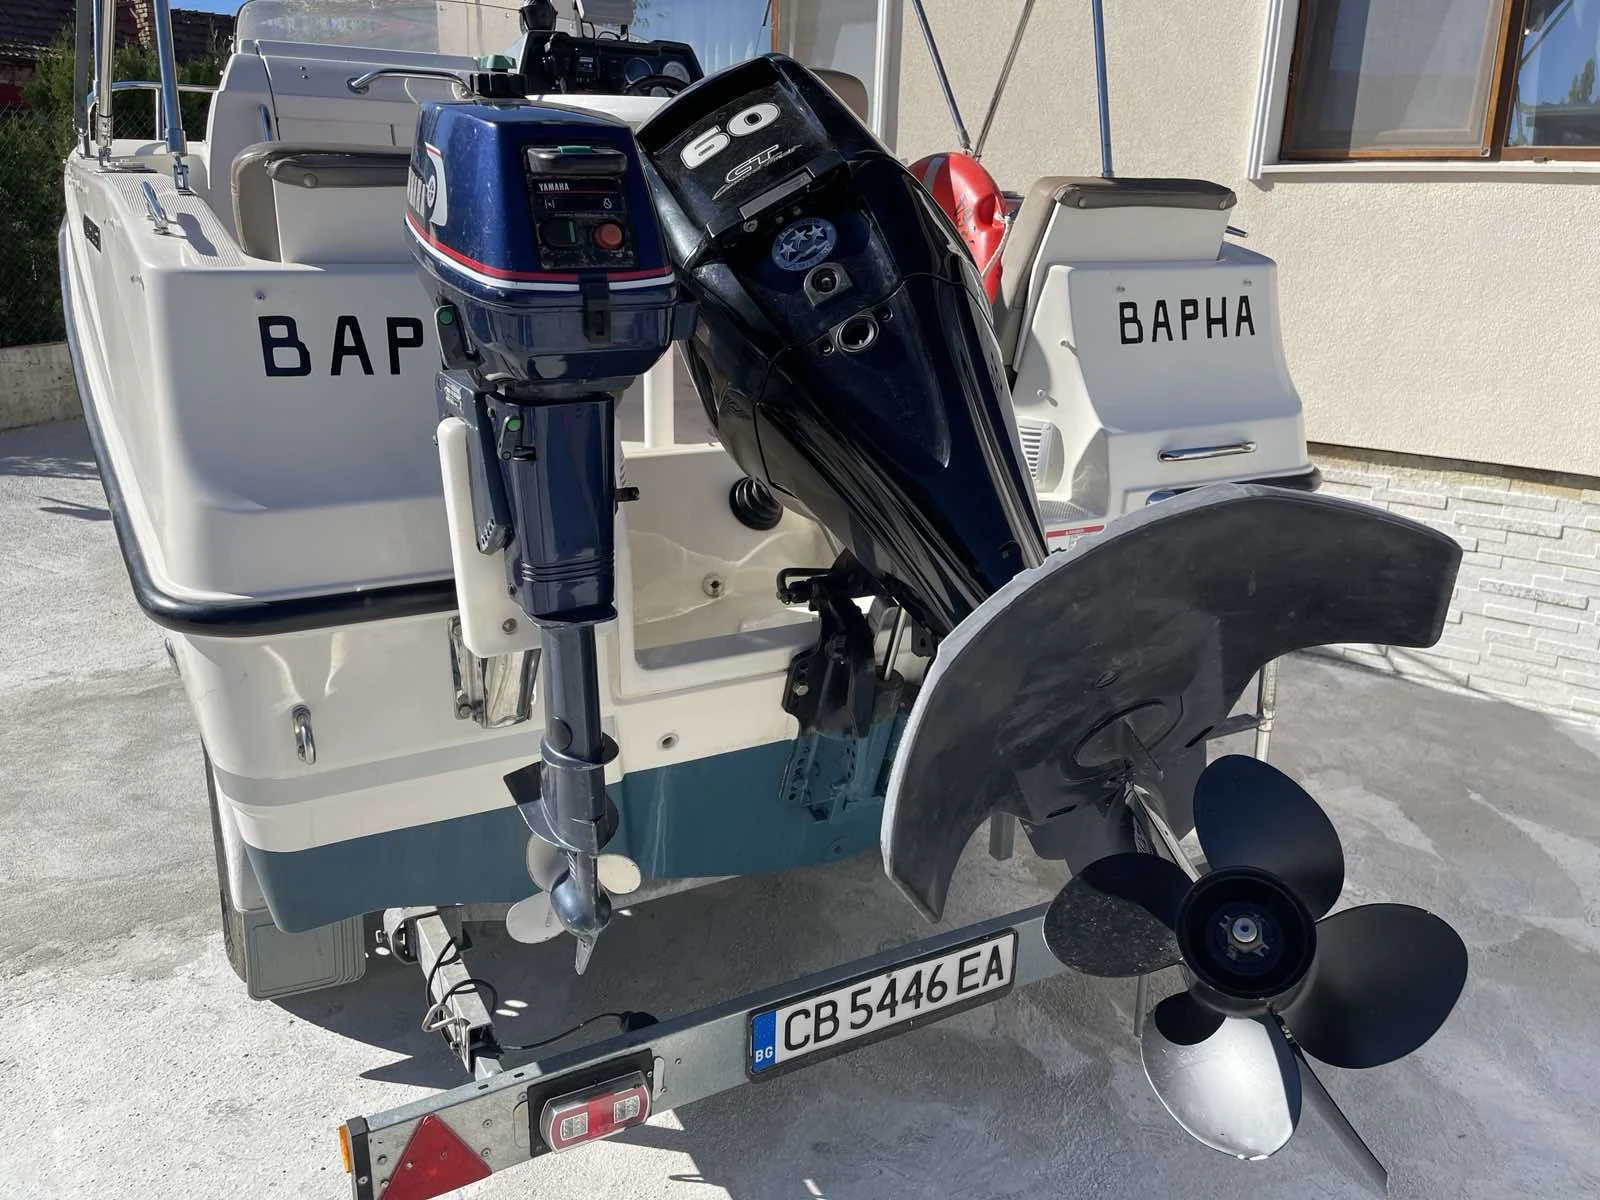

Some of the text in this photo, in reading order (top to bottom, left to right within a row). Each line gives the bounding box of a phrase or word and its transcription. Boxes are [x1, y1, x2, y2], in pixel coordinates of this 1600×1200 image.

[680, 102, 781, 170] 60
[538, 182, 570, 192] YAMAHA
[849, 963, 948, 1030] 5446
[754, 1046, 774, 1063] BG
